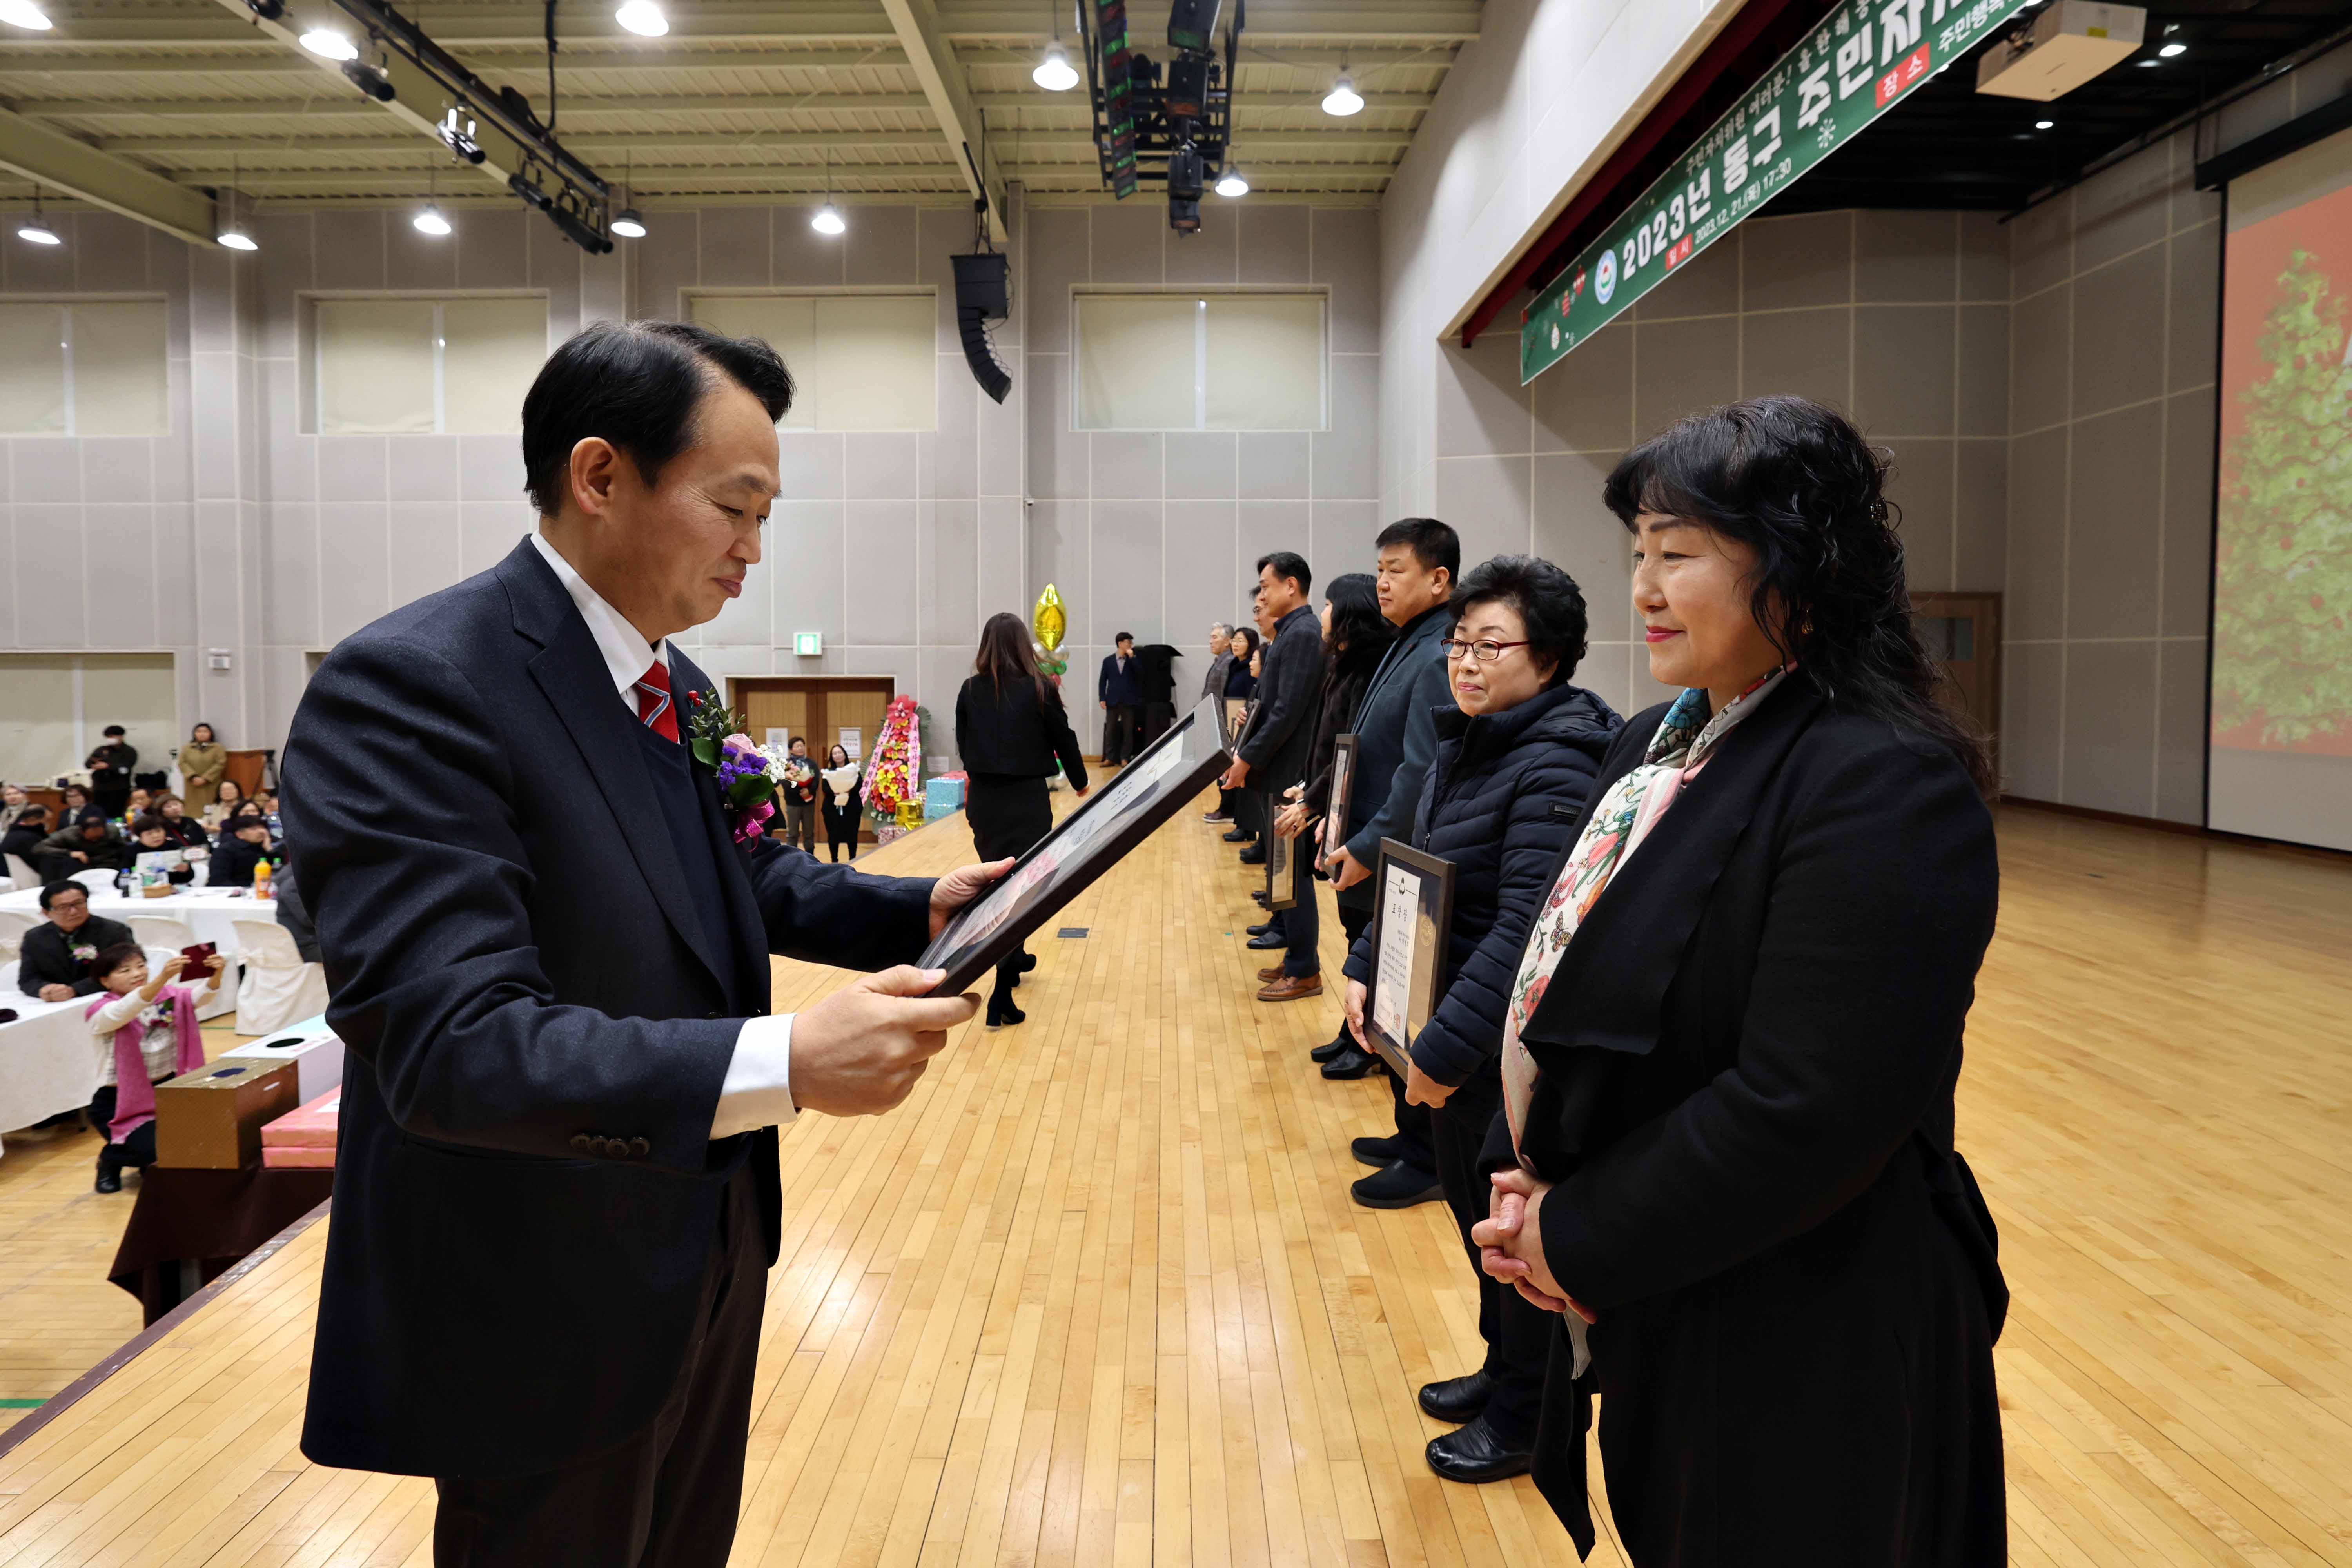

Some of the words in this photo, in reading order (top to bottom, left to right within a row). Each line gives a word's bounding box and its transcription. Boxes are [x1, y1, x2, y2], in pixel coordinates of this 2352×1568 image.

[1749, 64, 1792, 115] 여러분!
[1623, 167, 1711, 281] 2023년
[1723, 105, 1782, 194] 동구
[1763, 157, 1792, 191] 17:30
